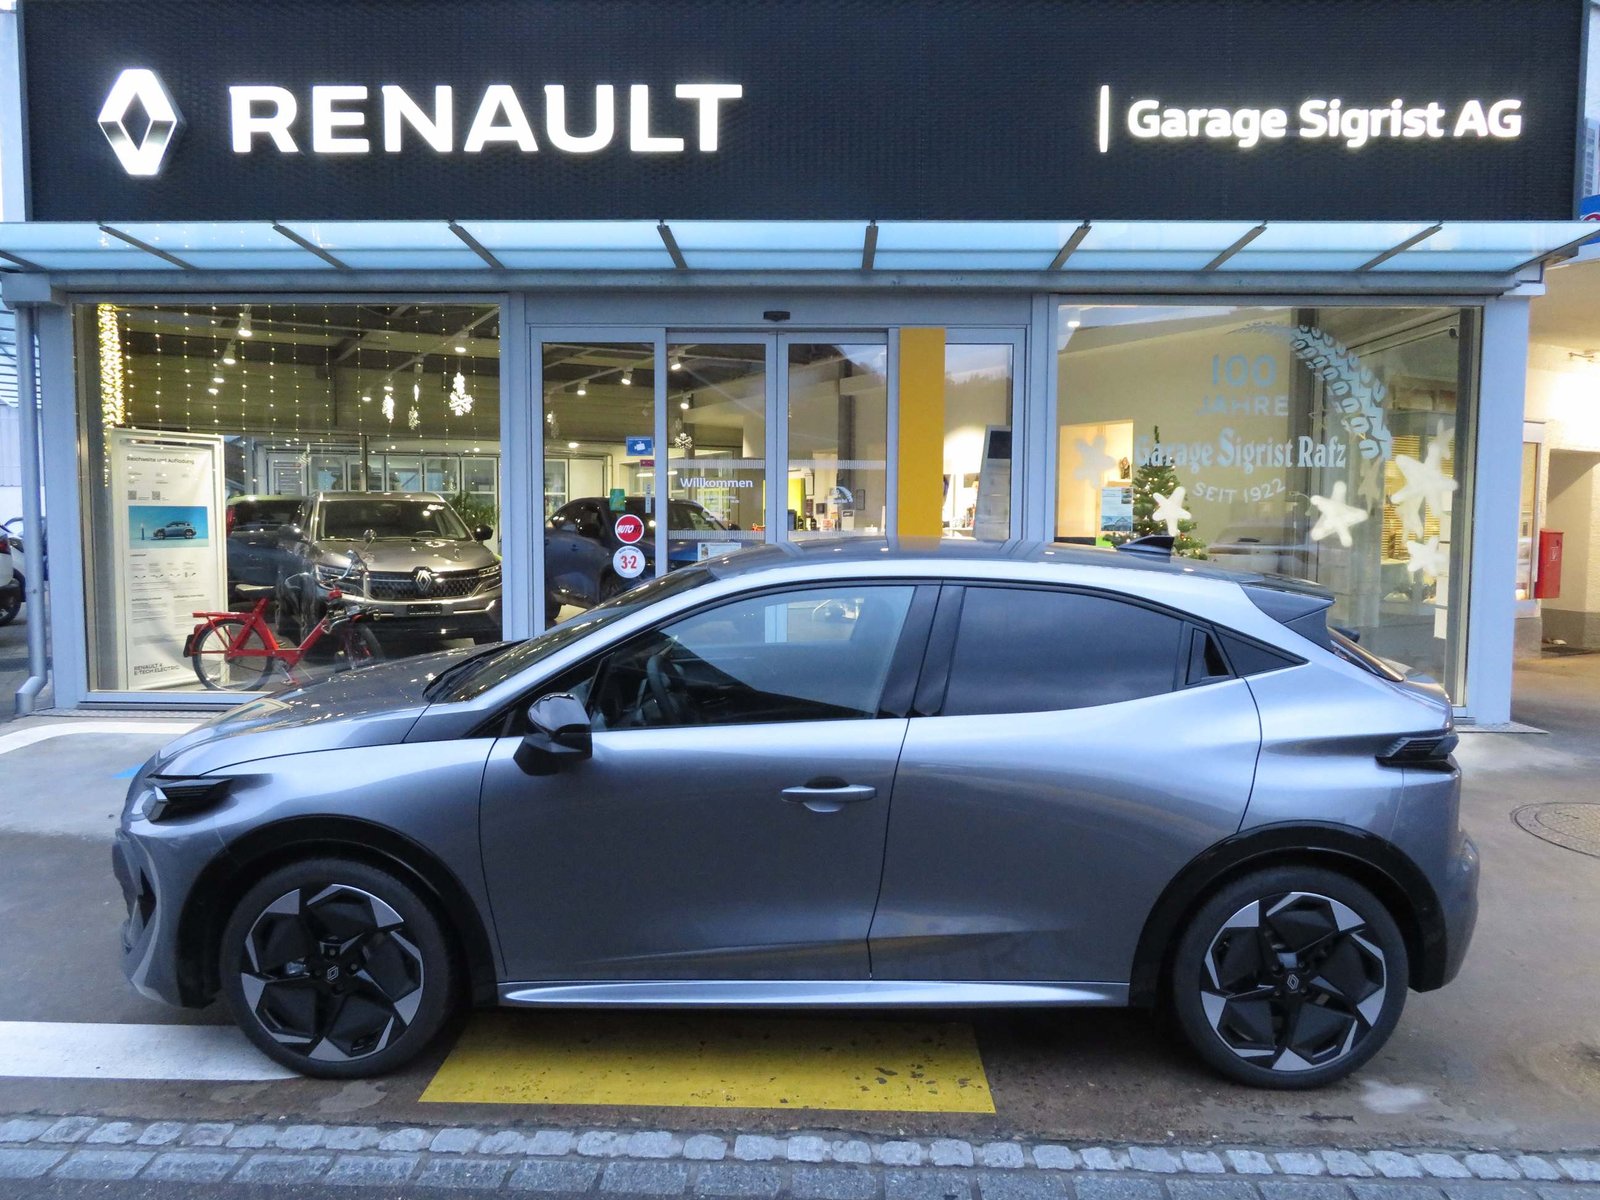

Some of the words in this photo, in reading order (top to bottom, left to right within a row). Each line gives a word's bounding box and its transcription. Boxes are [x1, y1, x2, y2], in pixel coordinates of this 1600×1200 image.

[228, 83, 743, 154] RENAULT
[1126, 98, 1288, 149] Garage
[1298, 97, 1446, 149] Sigrist
[1452, 98, 1523, 139] AG
[1212, 353, 1277, 388] 100
[1197, 394, 1289, 416] JAHRE
[1135, 435, 1213, 475] Garage
[1217, 427, 1294, 475] Sigrist
[1298, 435, 1347, 468] Rafz
[680, 477, 753, 488] Willkommen
[1192, 482, 1237, 504] SEIT
[1244, 478, 1287, 503] 1922
